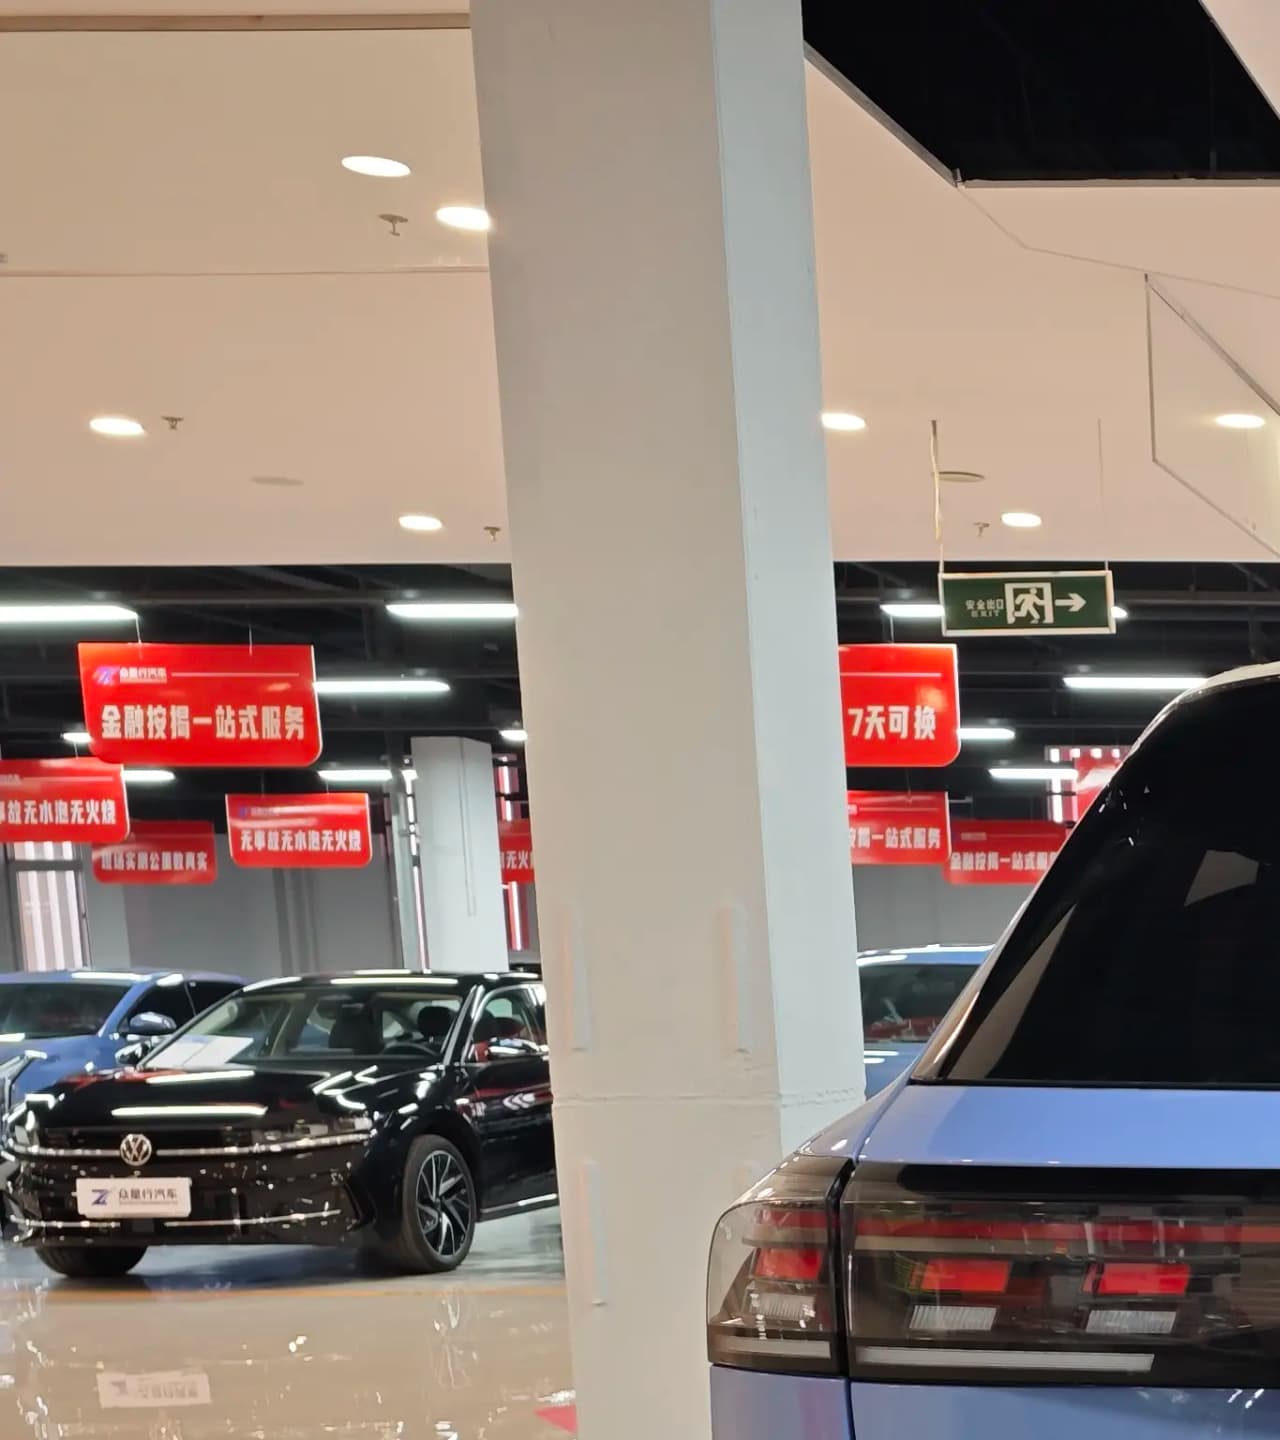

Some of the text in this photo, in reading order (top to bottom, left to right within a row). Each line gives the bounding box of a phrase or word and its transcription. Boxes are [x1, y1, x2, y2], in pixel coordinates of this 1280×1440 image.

[965, 598, 1004, 611] 安全出口
[101, 704, 305, 740] 金融按揭一站式服务
[847, 705, 936, 740] 7天可换
[240, 829, 362, 852] 无事故无水泡无火烧
